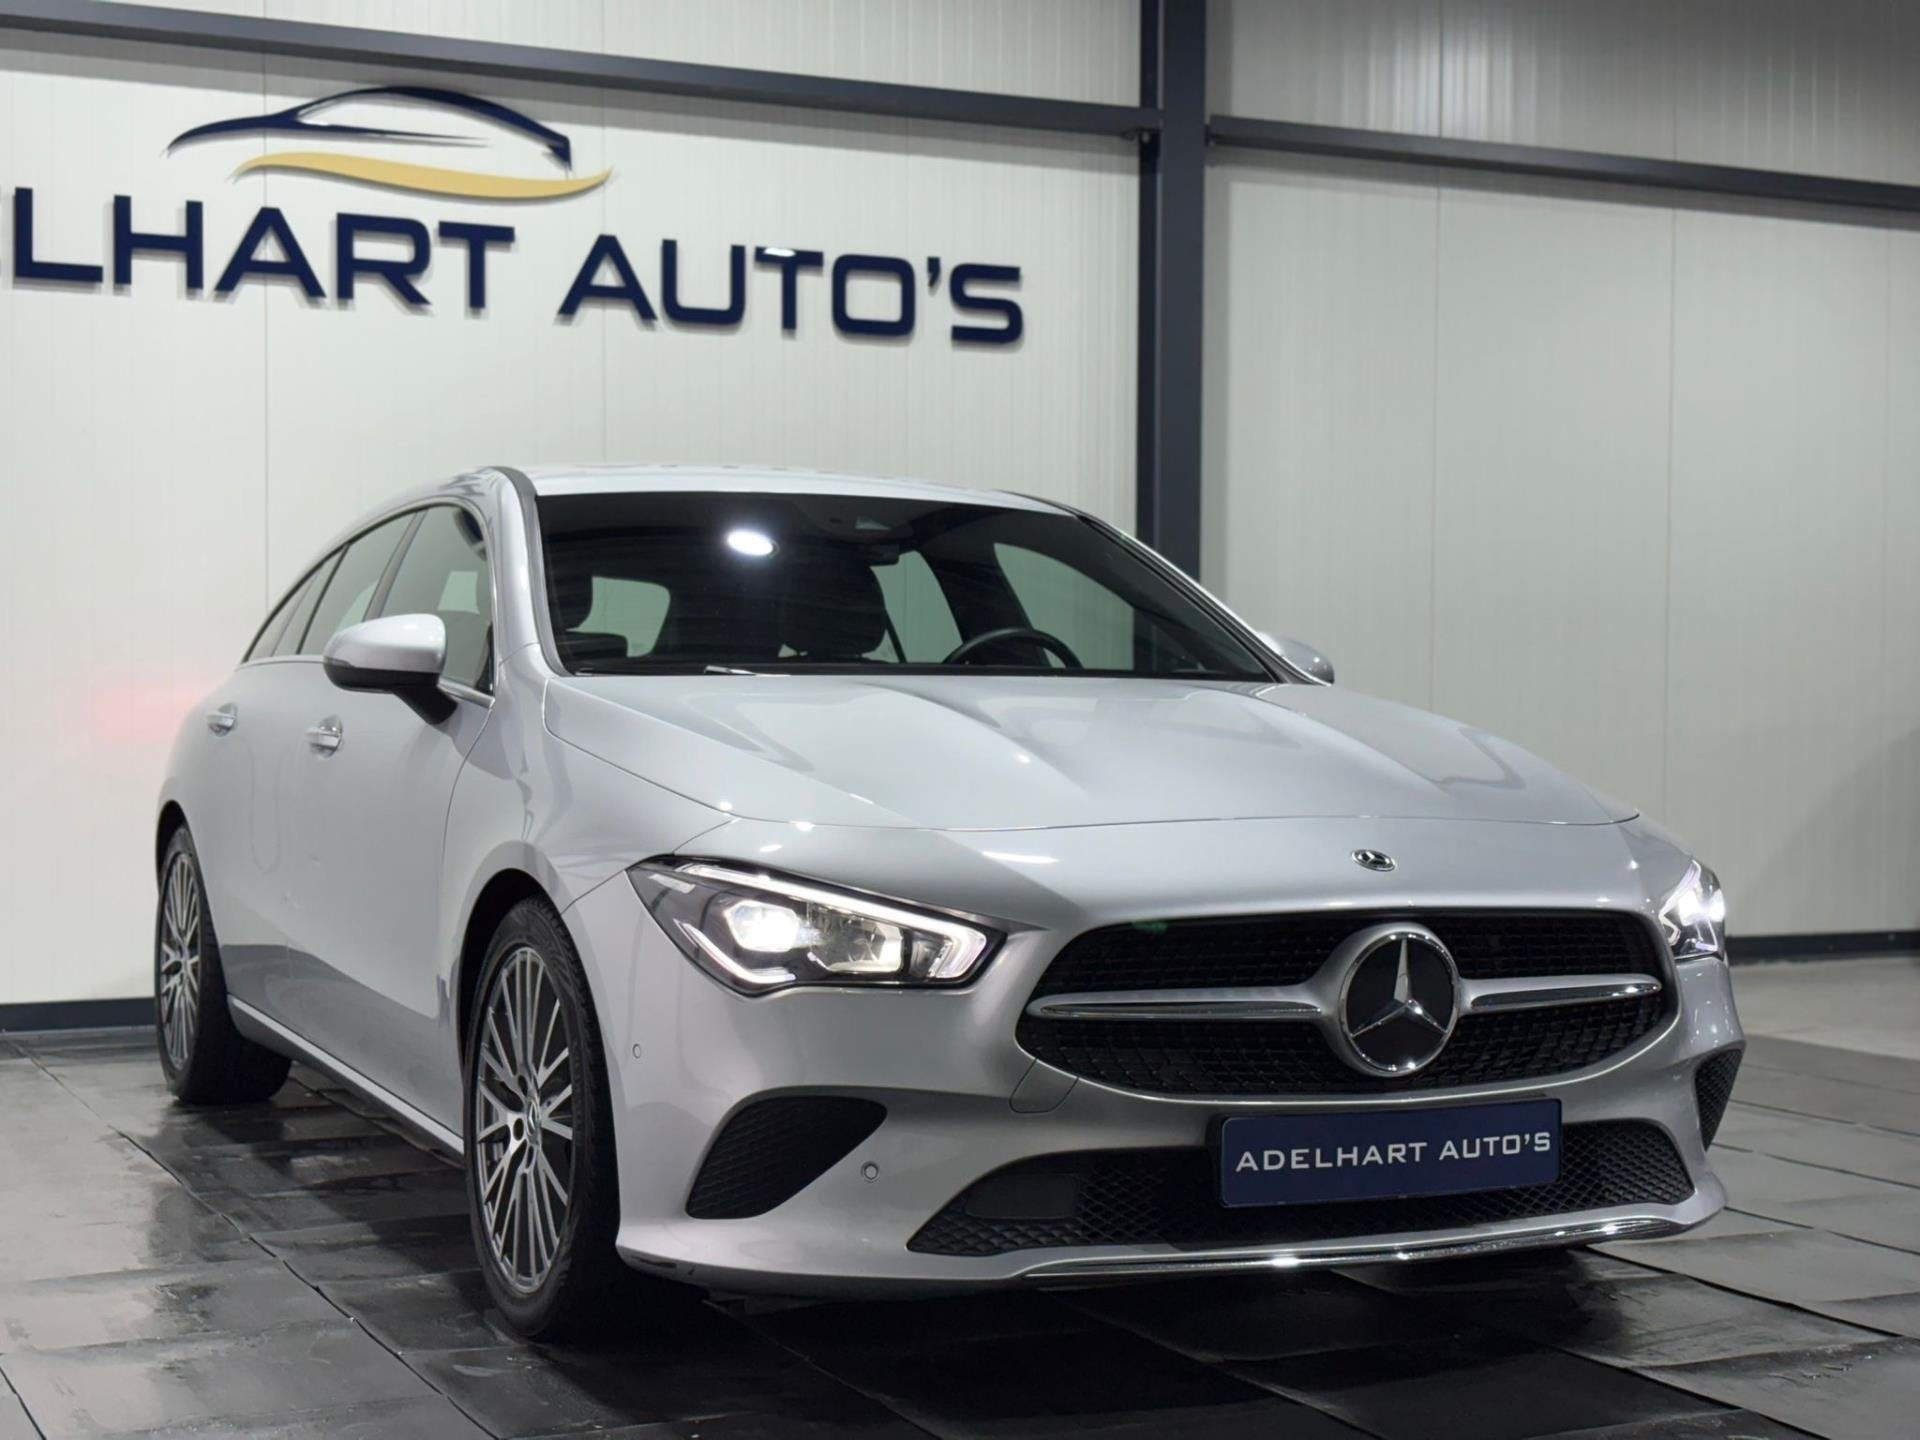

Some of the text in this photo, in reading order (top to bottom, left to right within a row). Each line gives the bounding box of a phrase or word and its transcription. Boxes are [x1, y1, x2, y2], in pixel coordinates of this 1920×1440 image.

[0, 186, 1023, 344] LHART AUTO'S
[1235, 1131, 1551, 1172] ADELHART AUTO'S
